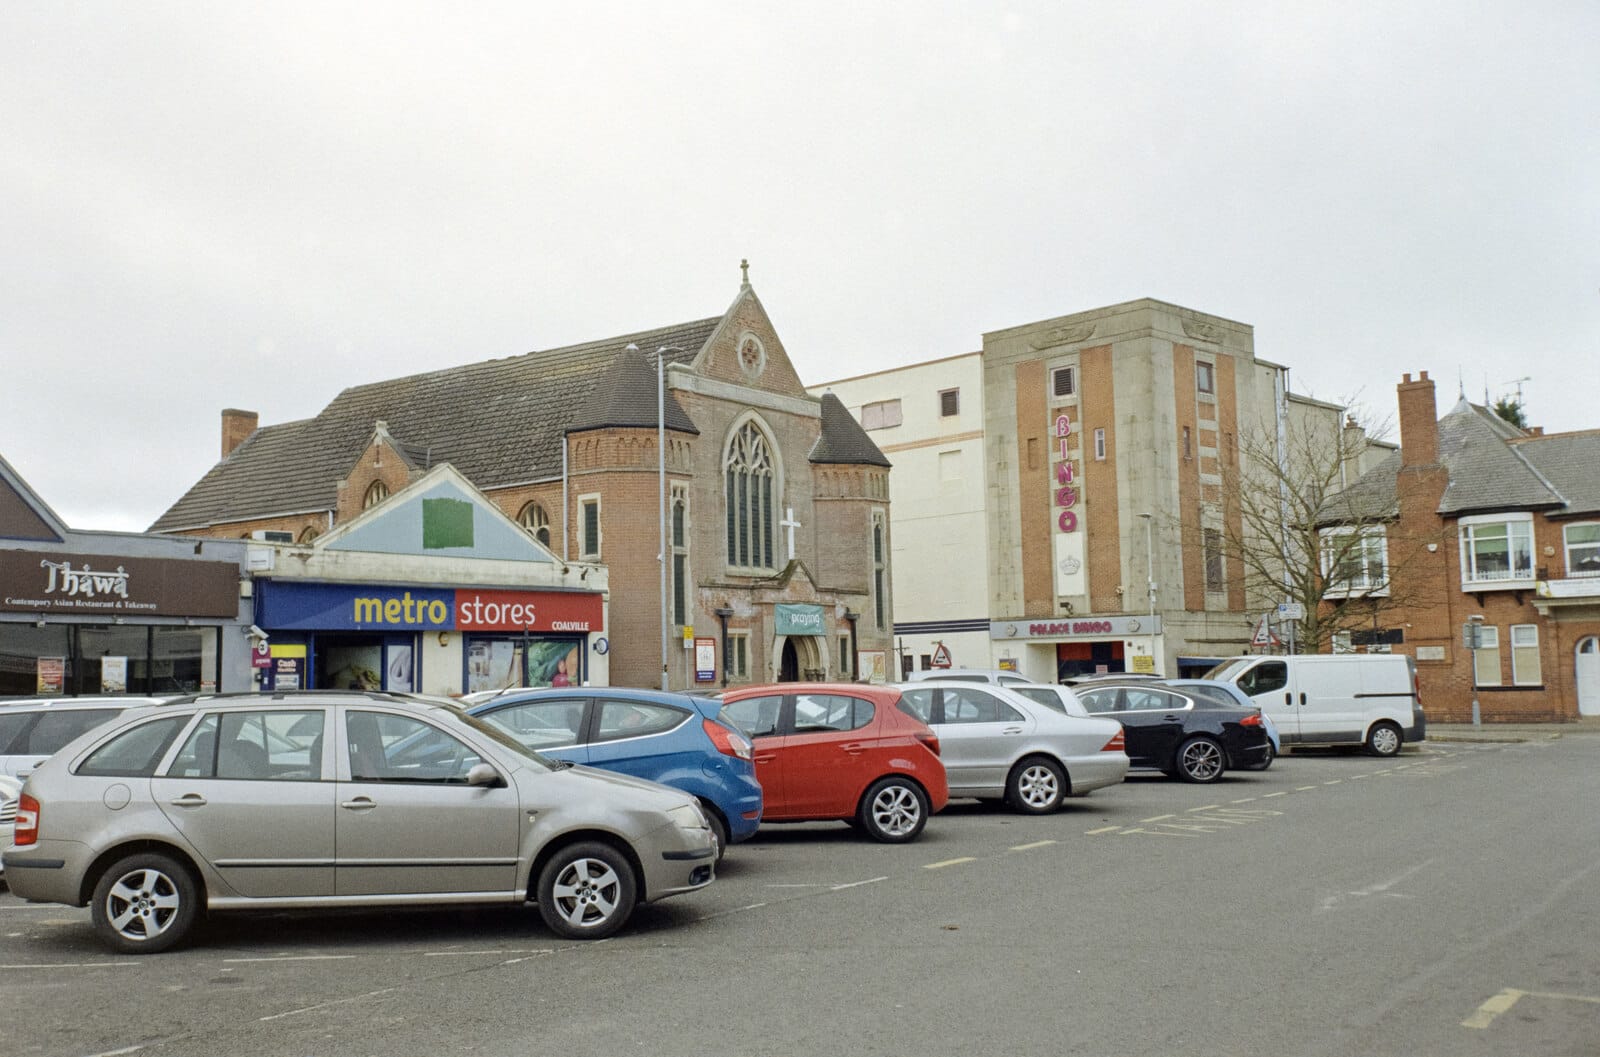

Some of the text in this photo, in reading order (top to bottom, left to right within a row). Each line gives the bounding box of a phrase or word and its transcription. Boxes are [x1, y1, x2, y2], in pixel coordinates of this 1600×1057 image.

[1055, 414, 1078, 533] BINGO
[54, 599, 74, 608] Asian
[75, 599, 114, 609] Restaurant
[115, 601, 122, 609] &
[124, 601, 157, 610] Takeaway
[353, 591, 536, 626] metro stores
[551, 621, 590, 632] COALVILLE
[791, 613, 820, 627] praying
[1029, 620, 1112, 636] PALACE BINGO
